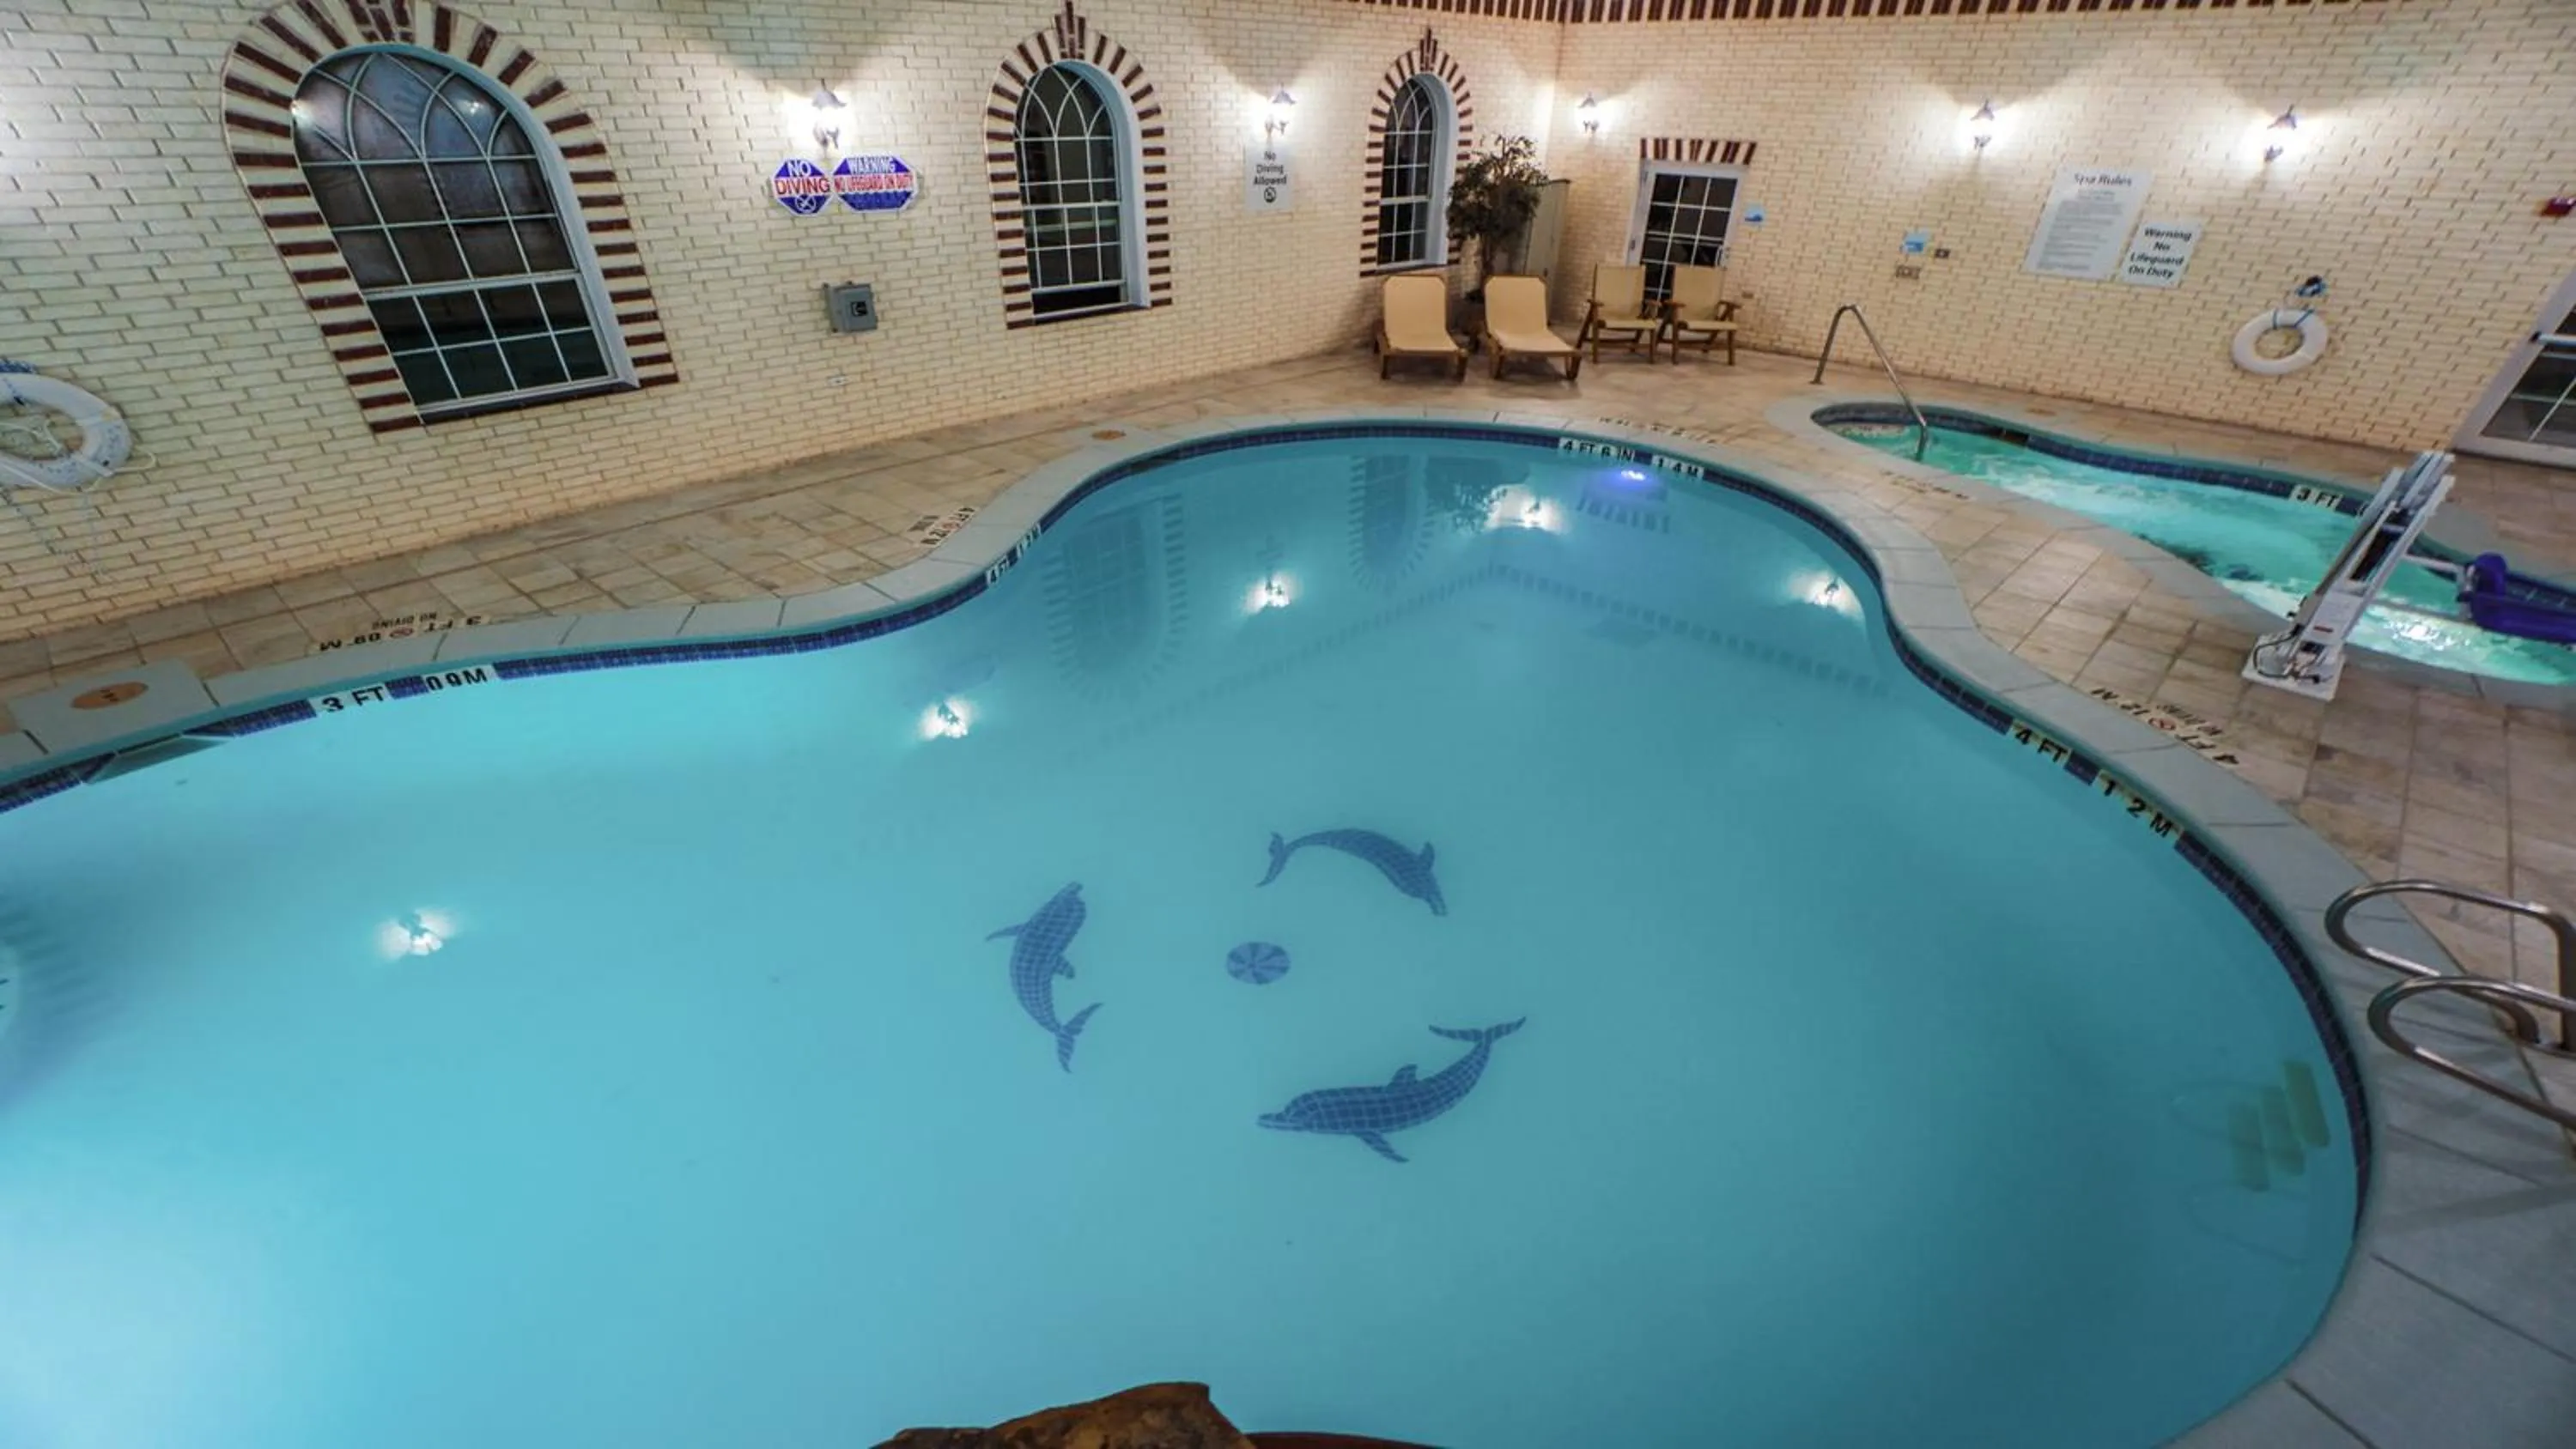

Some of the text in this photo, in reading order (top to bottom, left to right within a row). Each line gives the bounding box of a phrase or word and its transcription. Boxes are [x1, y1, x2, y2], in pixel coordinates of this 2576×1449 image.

[787, 160, 811, 177] NO
[775, 178, 829, 196] DIVING
[2145, 227, 2191, 241] Warning
[2153, 241, 2171, 252] No
[2130, 252, 2184, 267] Lifeguard
[2129, 265, 2174, 279] On Duty
[1563, 440, 1572, 451] 4
[2297, 488, 2338, 508] 3 FT
[322, 696, 343, 712] 3
[352, 686, 385, 706] FT
[2015, 726, 2033, 746] 4
[2037, 737, 2068, 763] FT
